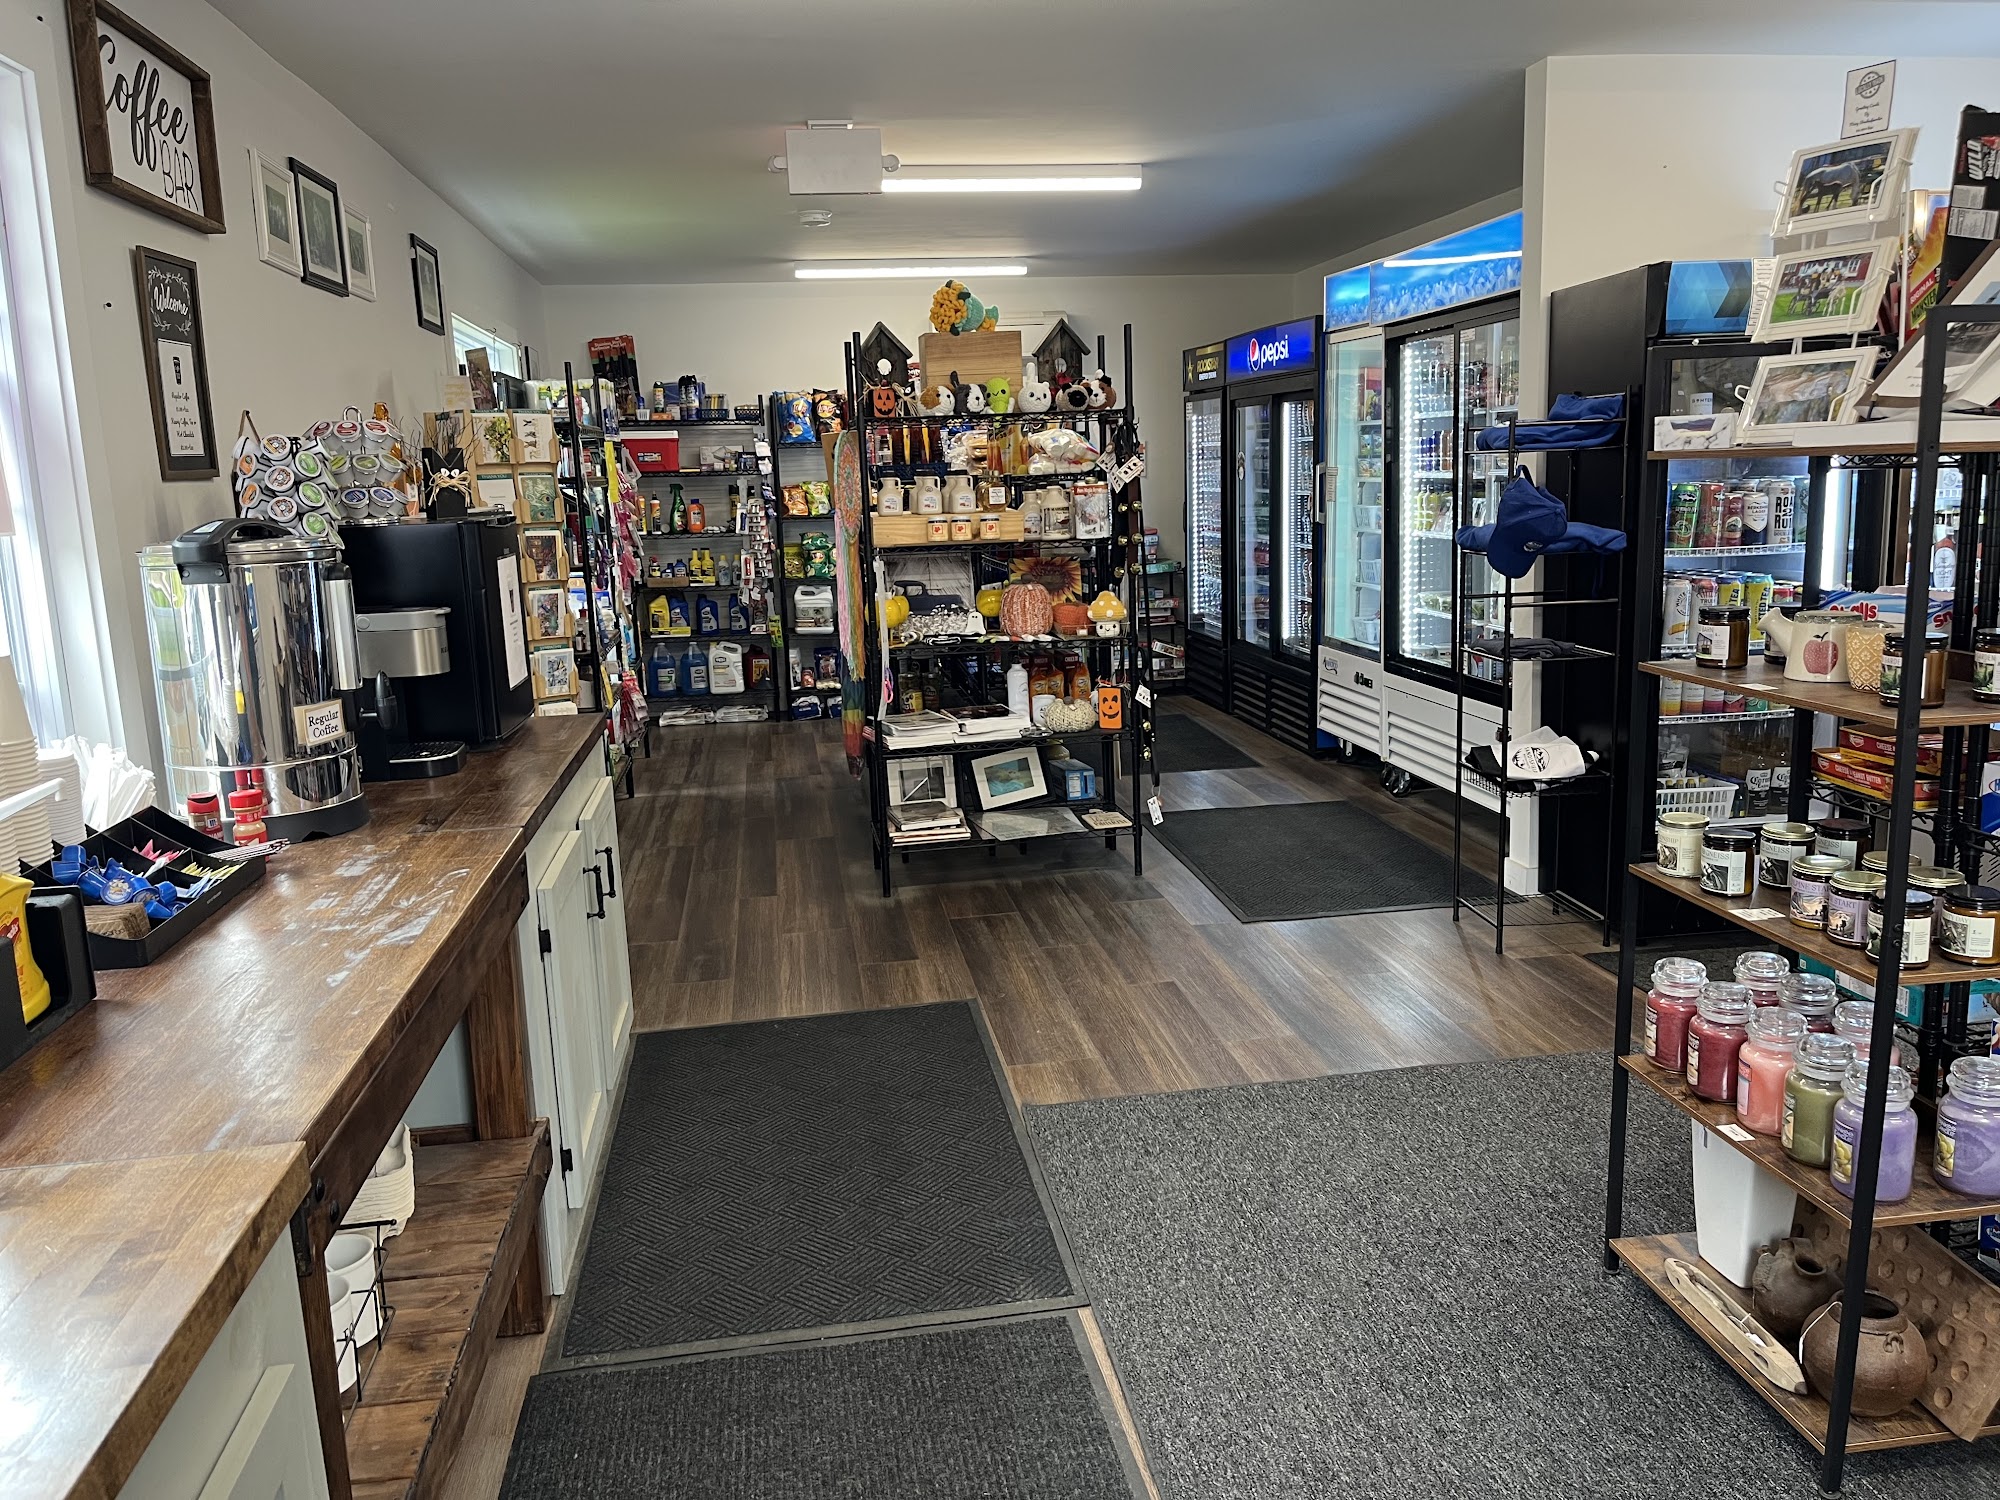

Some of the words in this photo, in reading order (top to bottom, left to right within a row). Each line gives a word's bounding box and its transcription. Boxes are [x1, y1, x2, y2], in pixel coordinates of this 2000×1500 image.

[160, 139, 199, 211] BAR
[1966, 139, 1984, 180] WILD
[153, 284, 189, 316] Welcome
[1260, 334, 1288, 369] pepsi
[308, 710, 338, 727] Regular
[313, 723, 339, 738] Coffee
